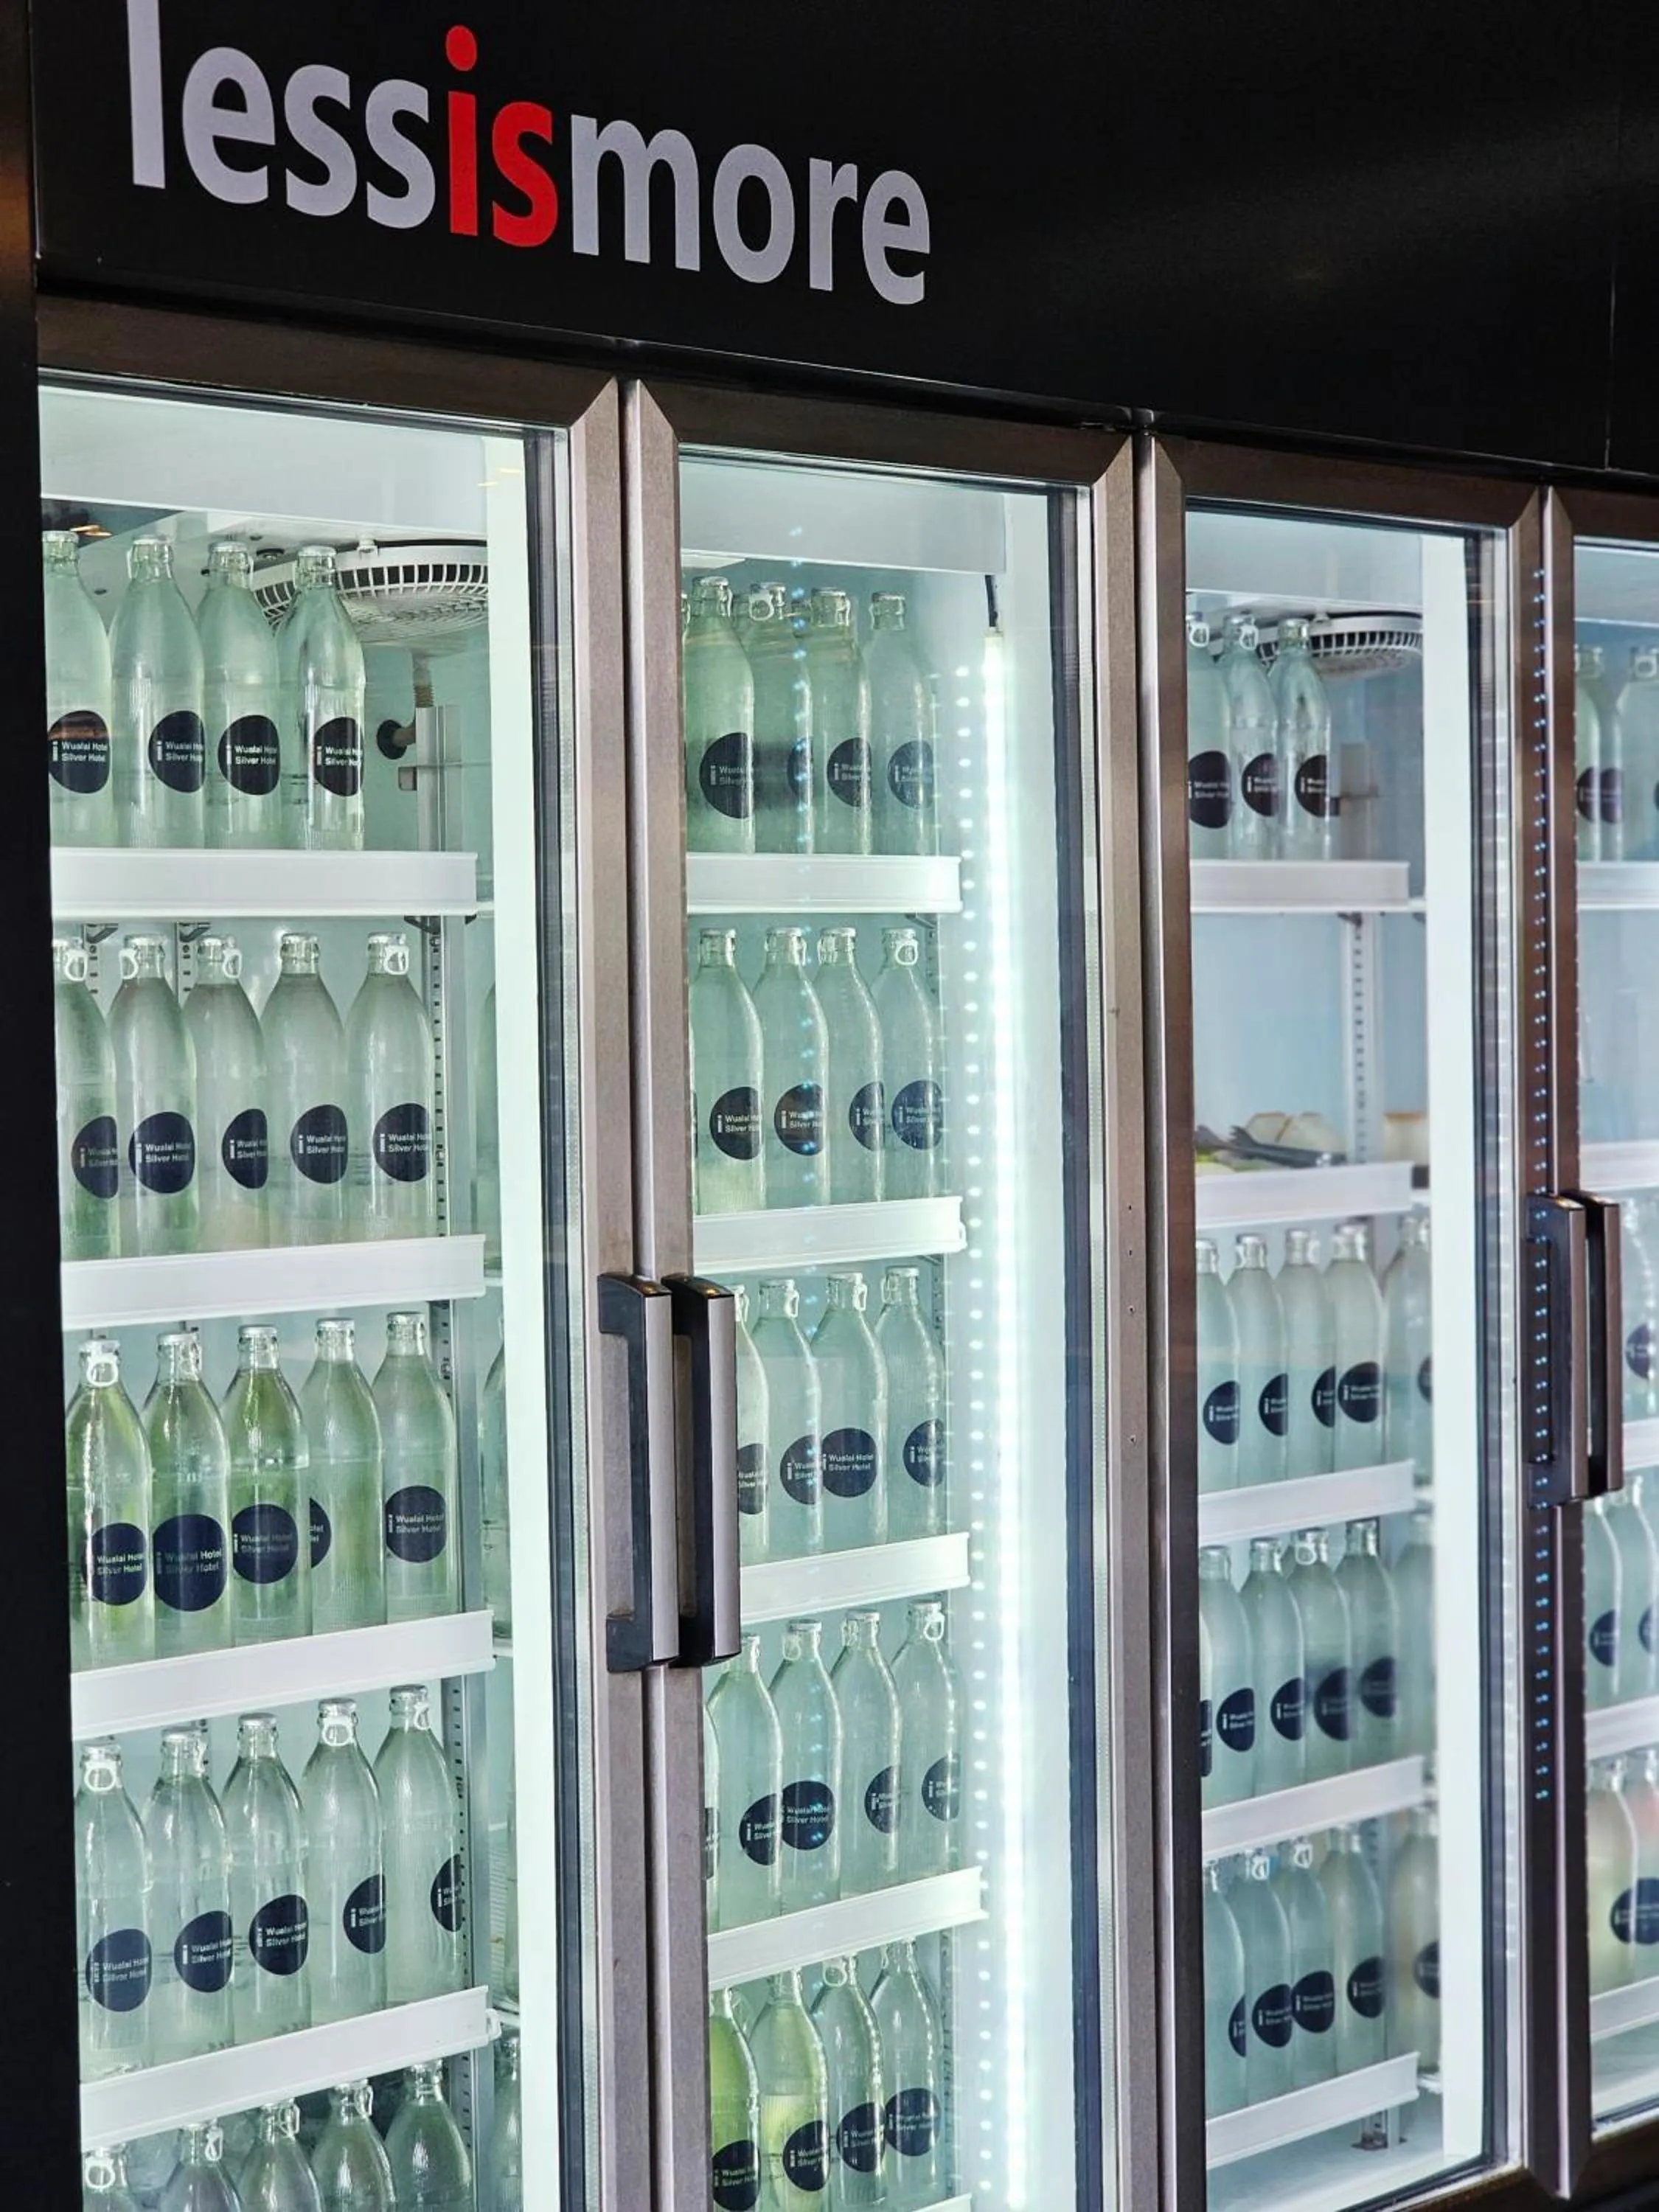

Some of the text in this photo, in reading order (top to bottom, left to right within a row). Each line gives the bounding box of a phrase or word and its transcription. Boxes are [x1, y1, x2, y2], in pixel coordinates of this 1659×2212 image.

[61, 741, 90, 751] Wualai
[234, 745, 262, 754] Wualai
[61, 752, 87, 762] Silver
[165, 753, 188, 761] Silver
[235, 757, 259, 765] Silver
[726, 1124, 748, 1133] Silver
[145, 1144, 174, 1152] Wualai
[307, 1146, 329, 1155] Silver
[145, 1155, 170, 1163] Silver
[829, 1454, 855, 1462] Wualai
[829, 1464, 851, 1472] Silver
[396, 1514, 423, 1523] Wualai
[396, 1526, 420, 1534] Silver
[201, 1548, 222, 1559] Hotel
[97, 1554, 125, 1564] Wualai
[123, 1563, 142, 1572] Hotel
[266, 1938, 290, 1947] Silver
[102, 1961, 131, 1970] Wualai
